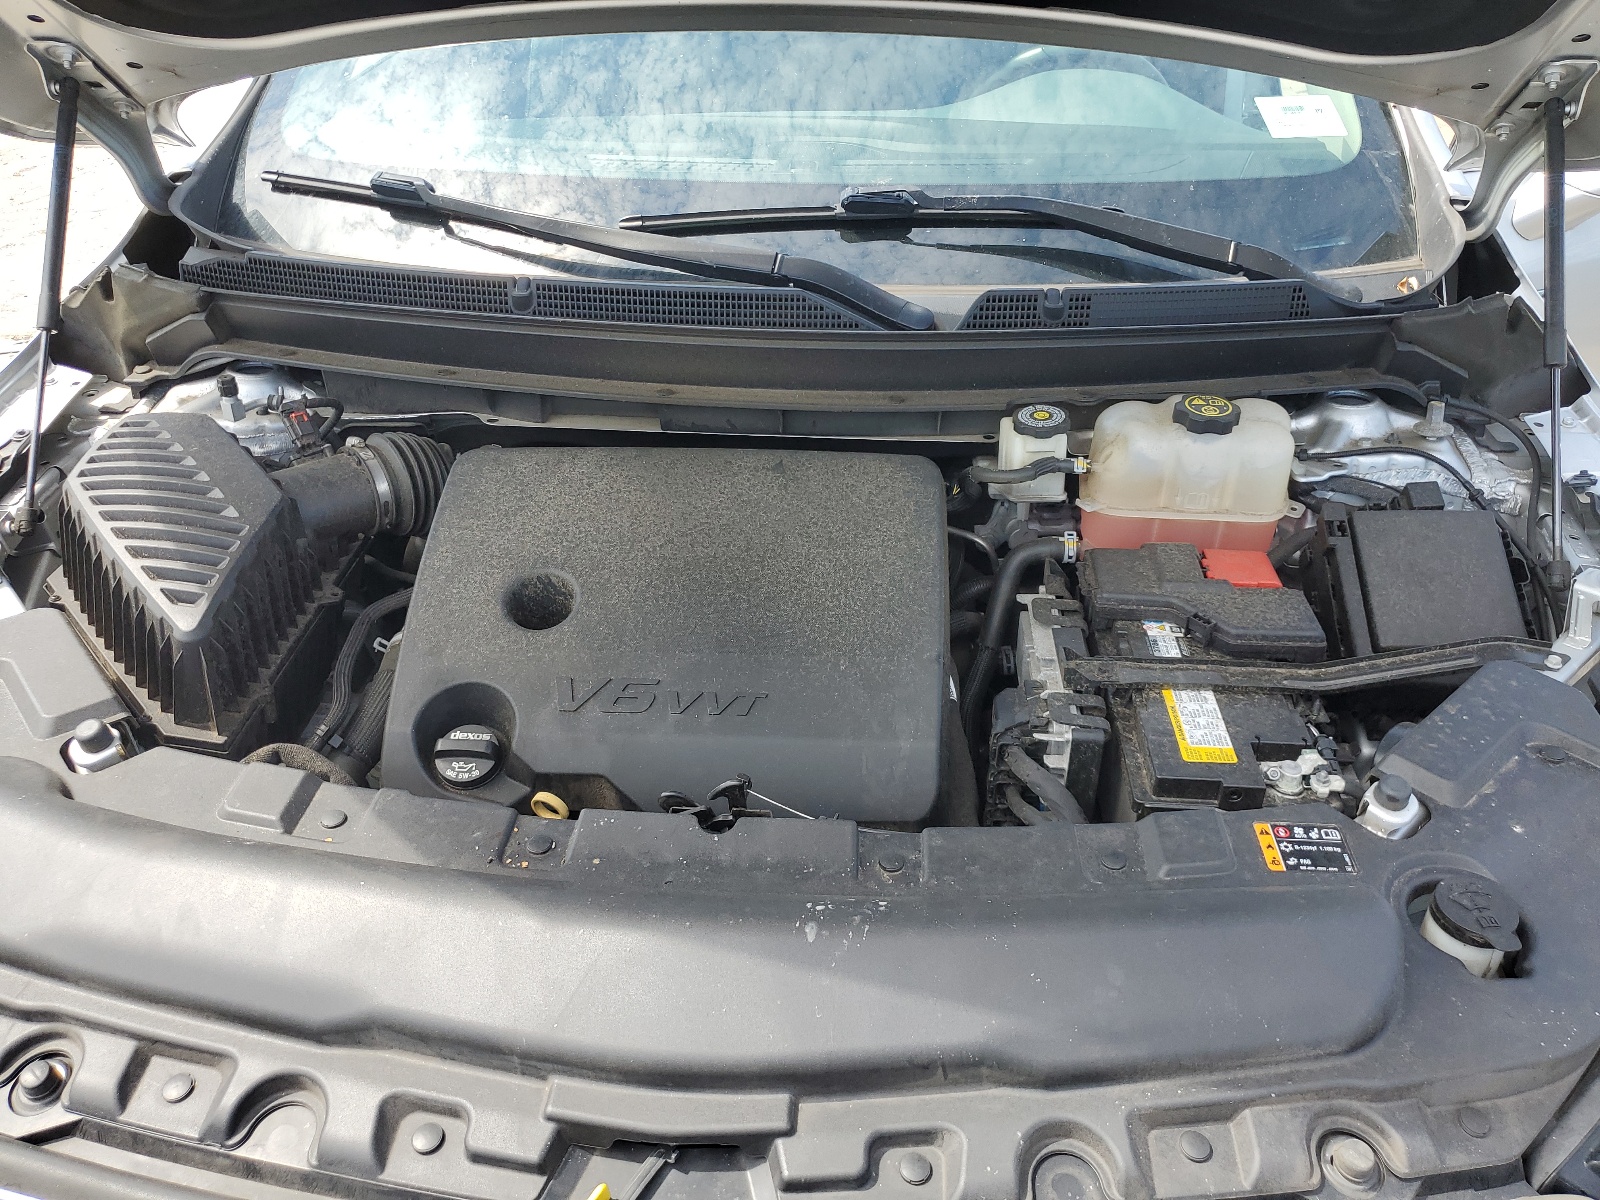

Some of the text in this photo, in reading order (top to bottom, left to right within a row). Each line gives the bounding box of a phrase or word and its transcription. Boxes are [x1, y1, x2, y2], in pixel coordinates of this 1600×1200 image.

[556, 678, 769, 716] V6 VVT
[450, 730, 492, 741] dexos
[445, 768, 480, 779] SAE 5W-30
